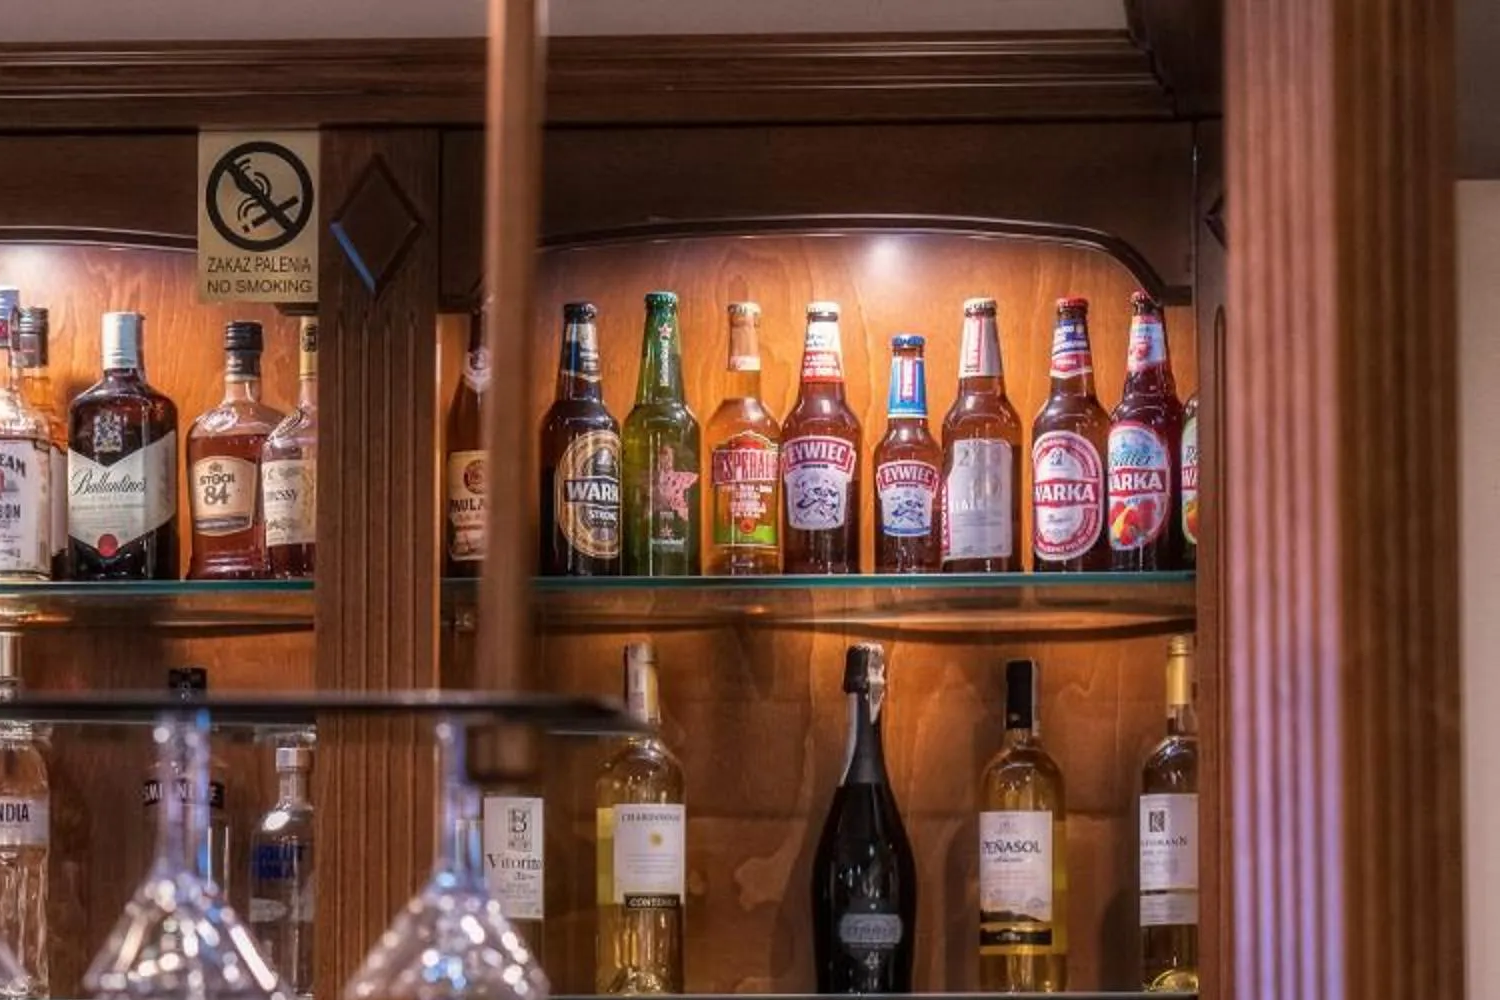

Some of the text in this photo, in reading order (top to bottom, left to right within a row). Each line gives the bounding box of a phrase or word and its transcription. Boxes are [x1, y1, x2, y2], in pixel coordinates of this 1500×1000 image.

[207, 257, 311, 273] ZAKAZ PALENIA
[207, 279, 313, 294] NO SMOKING
[1108, 471, 1163, 491] ARKA
[204, 483, 231, 505] 84
[567, 481, 619, 502] WAR
